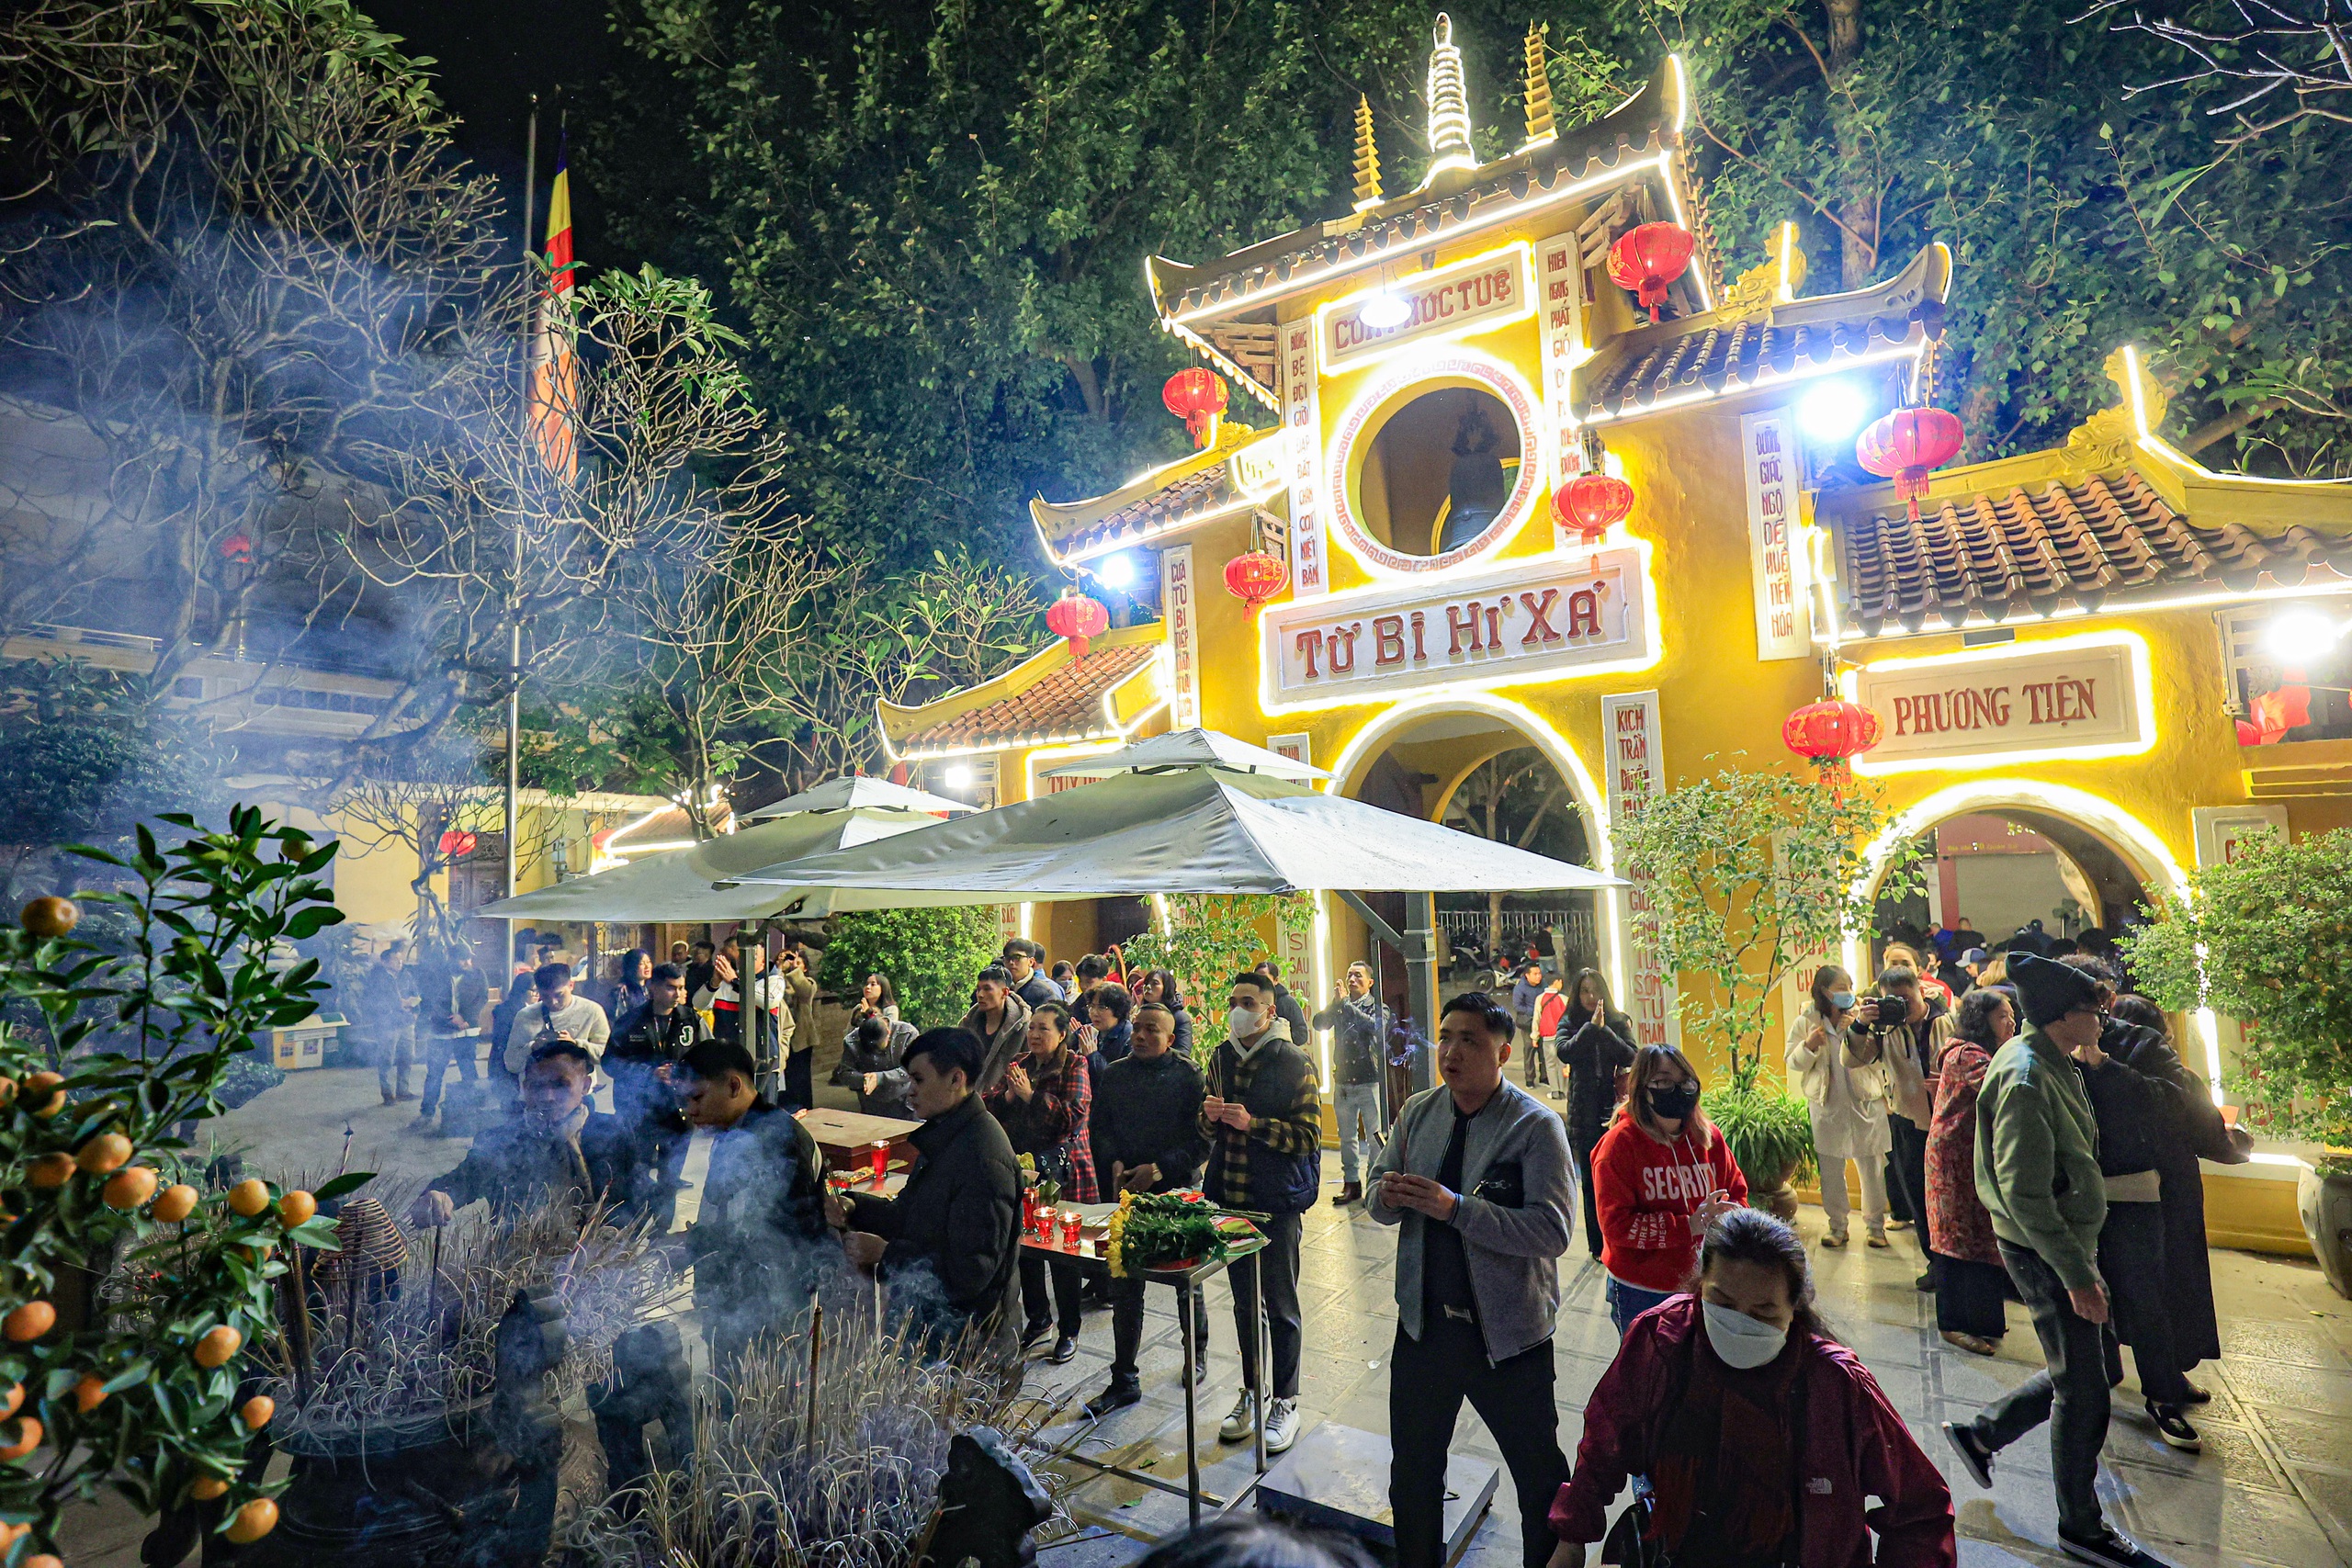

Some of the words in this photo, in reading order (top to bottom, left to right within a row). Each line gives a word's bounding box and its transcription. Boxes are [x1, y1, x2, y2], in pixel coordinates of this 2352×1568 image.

[1760, 456, 1783, 486] GIÁC
[1761, 490, 1784, 518] NGỘ
[1175, 609, 1187, 630] BI
[1894, 686, 2010, 736] PHƯƠNG
[2022, 675, 2098, 727] TIỆN
[680, 1025, 694, 1046] J
